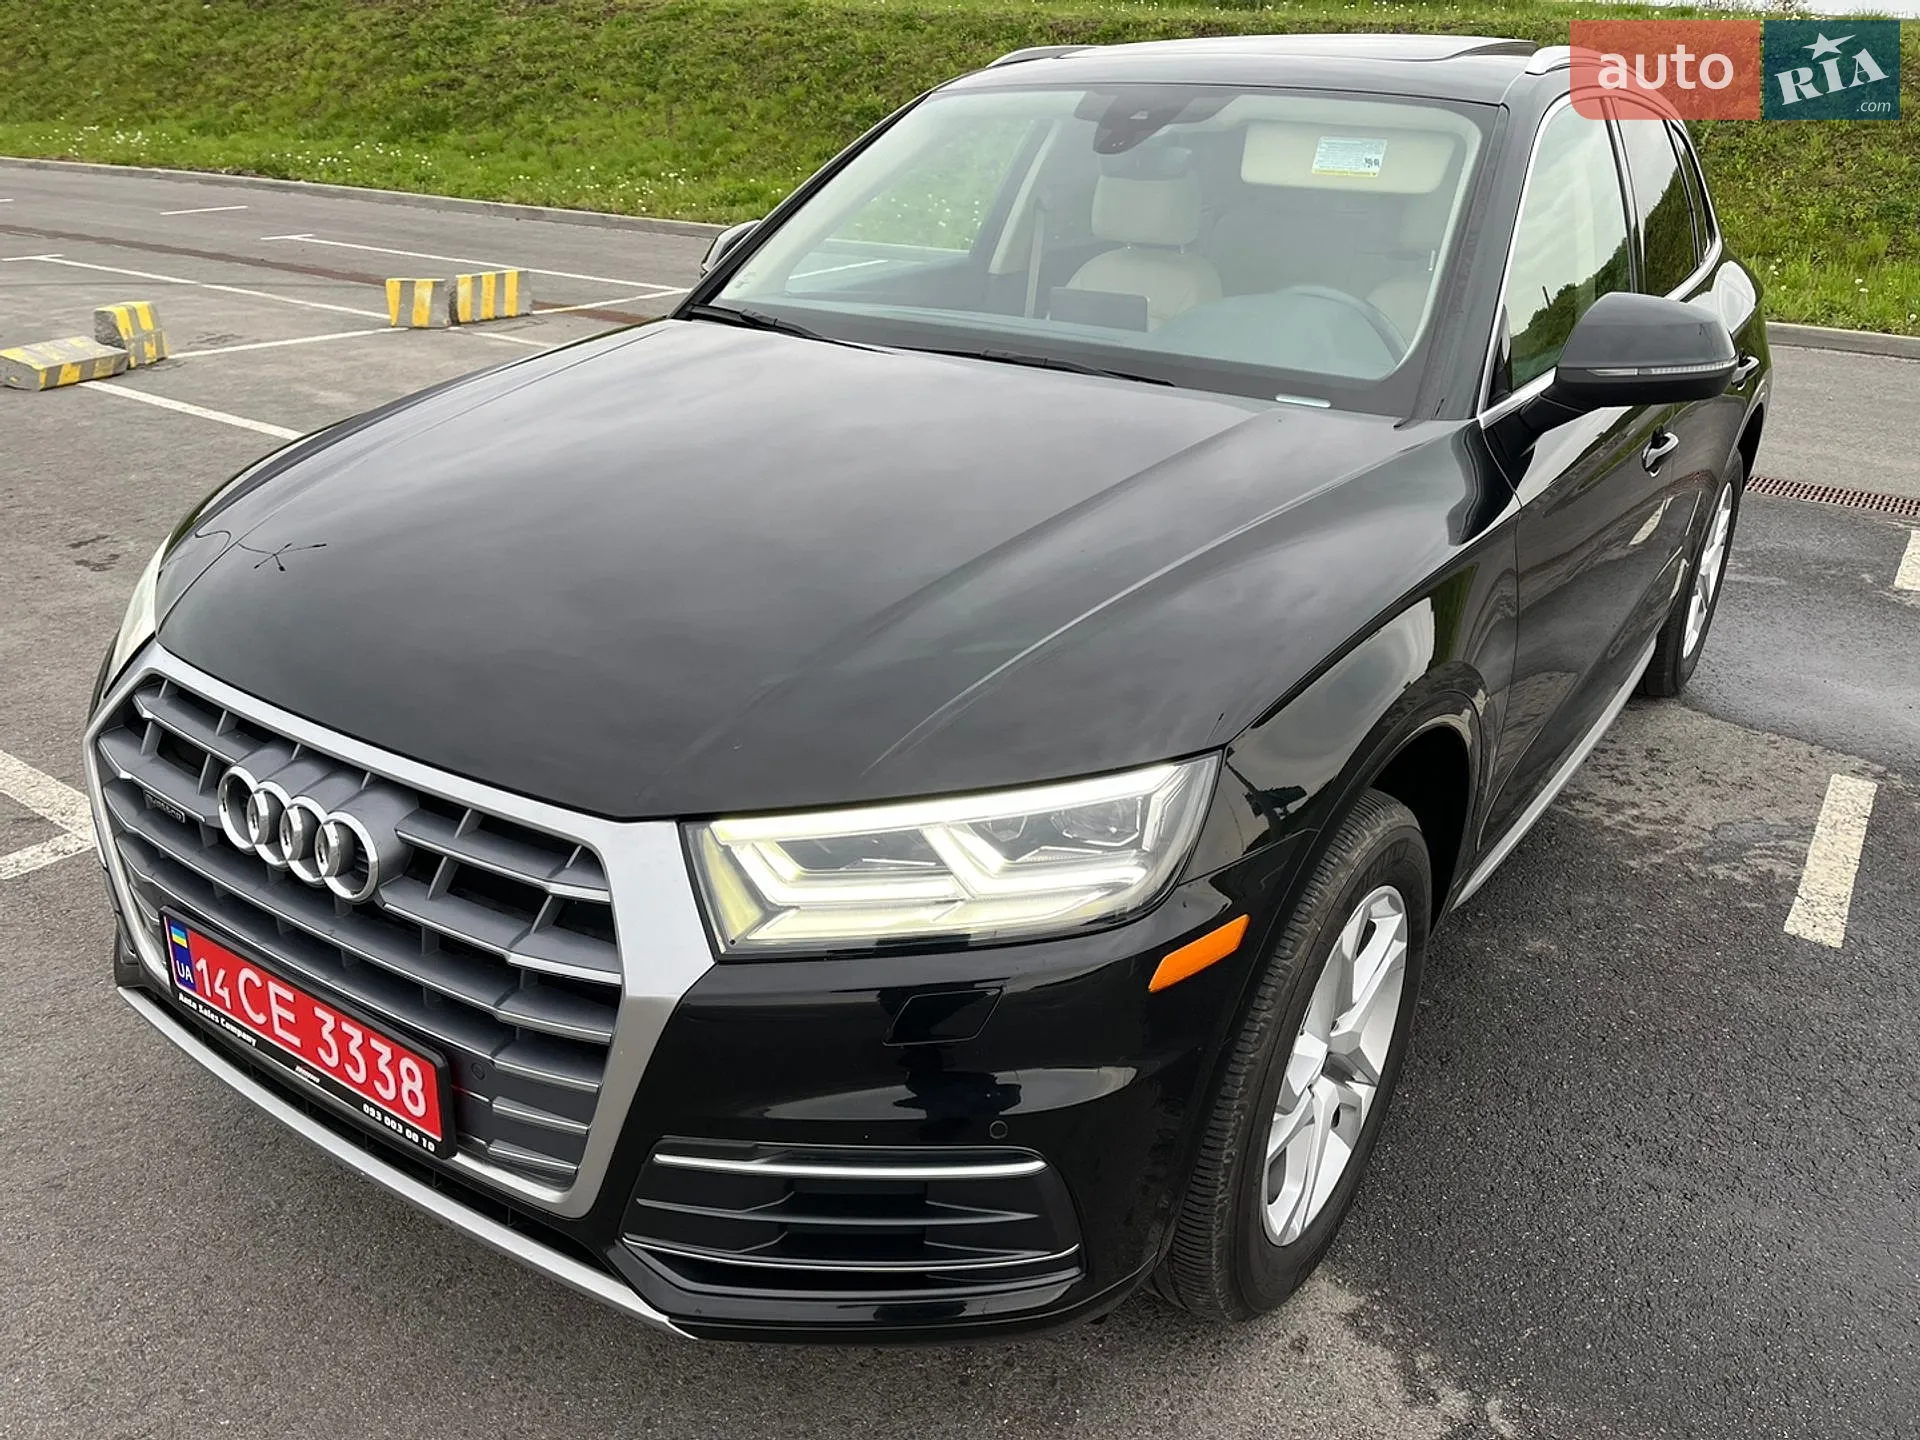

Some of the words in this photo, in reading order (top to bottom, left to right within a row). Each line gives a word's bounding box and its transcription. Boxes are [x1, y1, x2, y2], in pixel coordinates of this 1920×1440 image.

[176, 959, 195, 984] UA
[198, 1003, 219, 1024] Sales
[220, 1017, 257, 1047] Company
[314, 1006, 427, 1118] 3338
[363, 1103, 382, 1121] 093
[384, 1115, 403, 1133] 003
[405, 1128, 419, 1143] 00
[422, 1137, 435, 1152] 10
